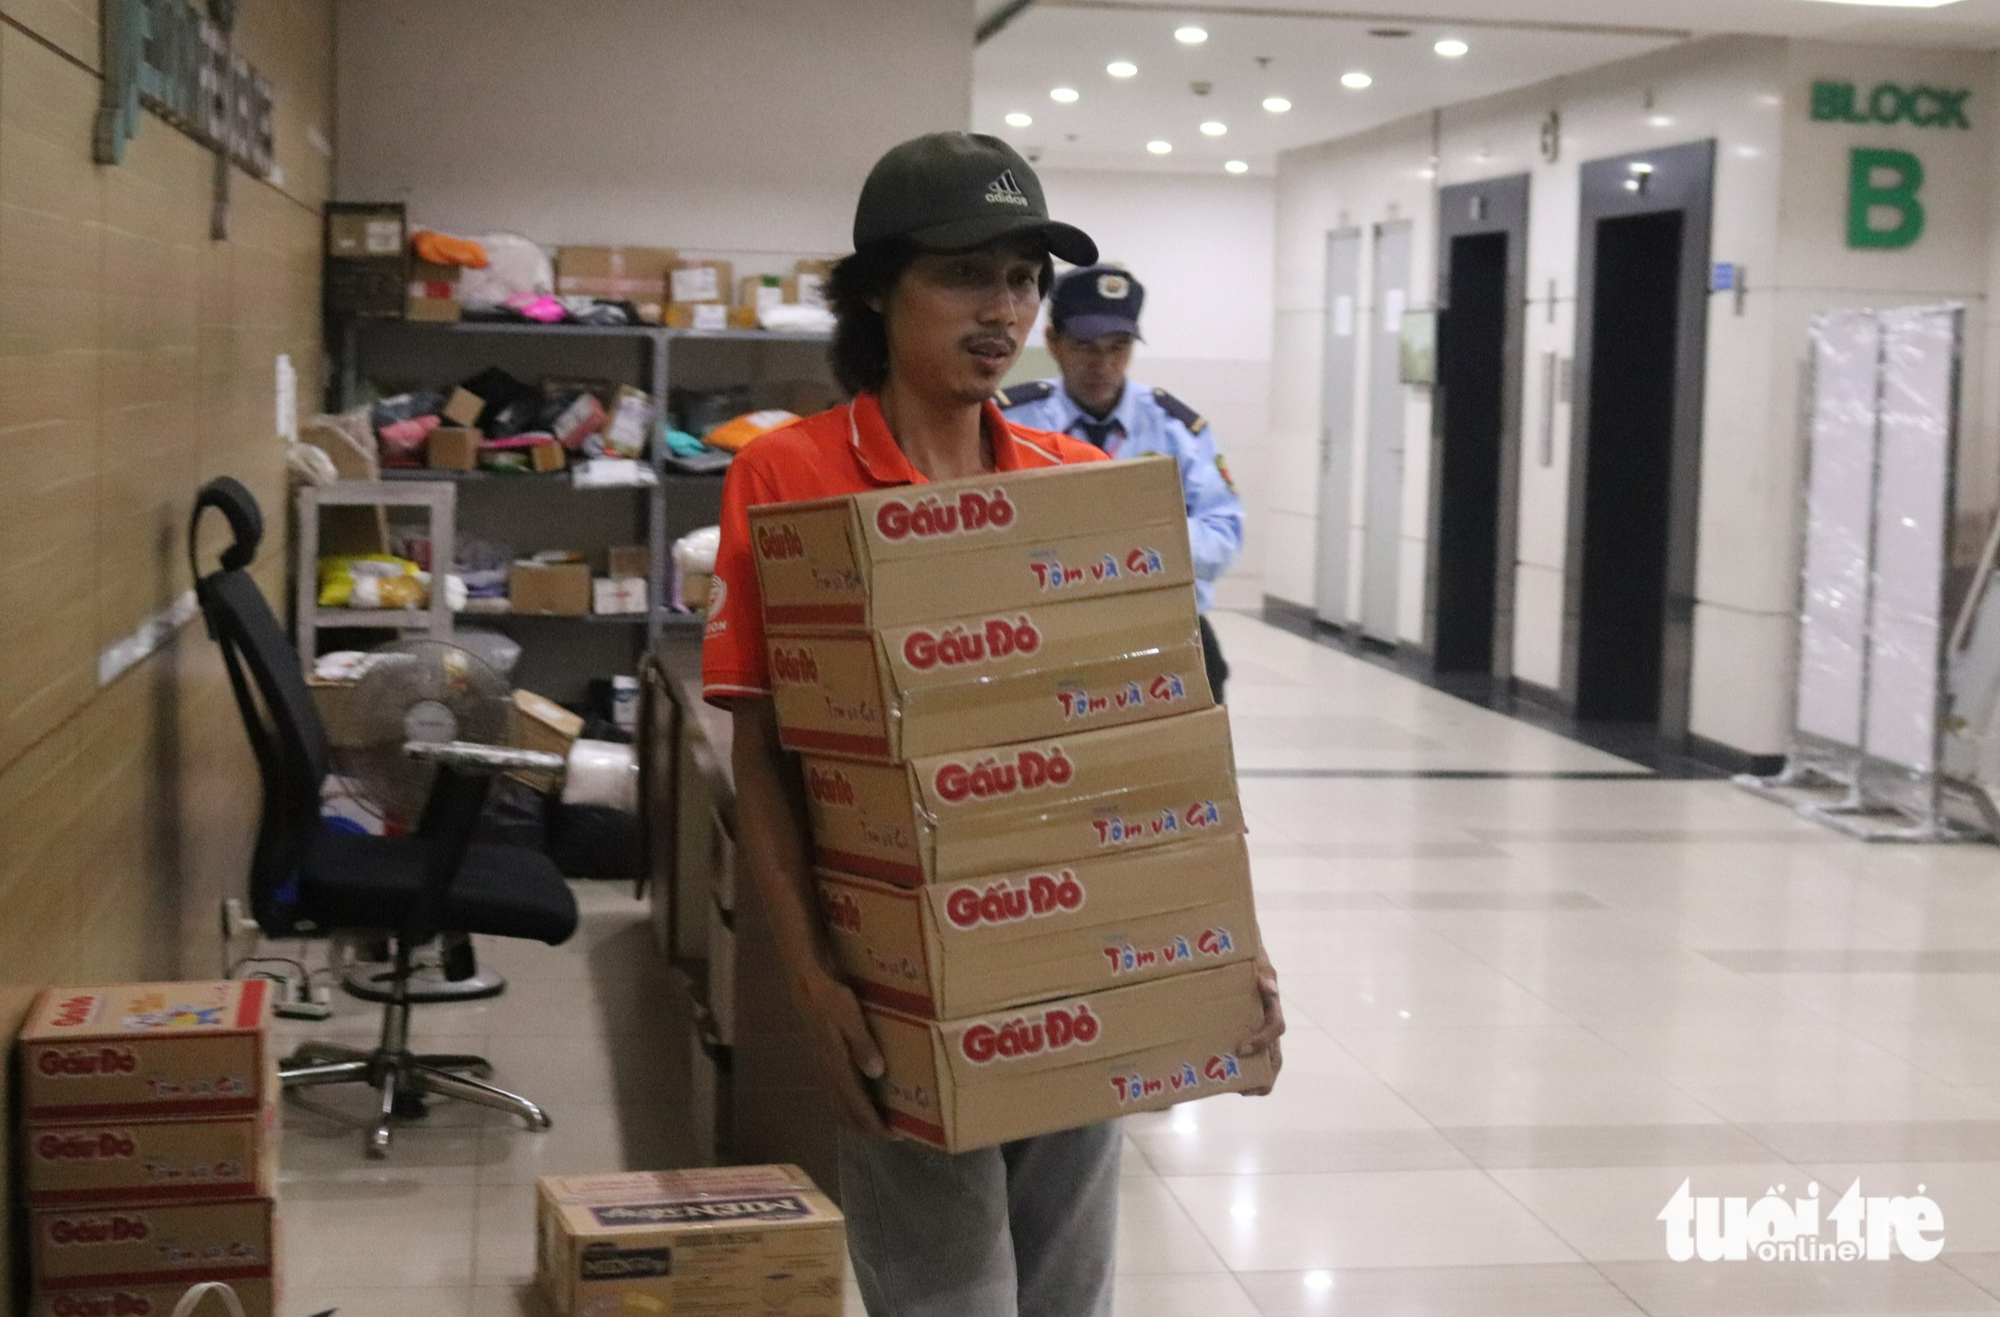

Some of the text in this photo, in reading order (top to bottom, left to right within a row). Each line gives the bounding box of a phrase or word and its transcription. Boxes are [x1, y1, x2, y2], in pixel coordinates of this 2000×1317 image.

[1811, 80, 1972, 130] BLOCK
[985, 191, 1028, 207] adidas
[1848, 149, 1924, 248] B
[1030, 548, 1162, 589] Tôm và Gà
[1057, 673, 1184, 717] Tôm và Gà
[1092, 800, 1219, 845] Tôm và Gà
[1103, 927, 1232, 973] Tôm và Gà
[1111, 1054, 1238, 1101] Tôm và Gà
